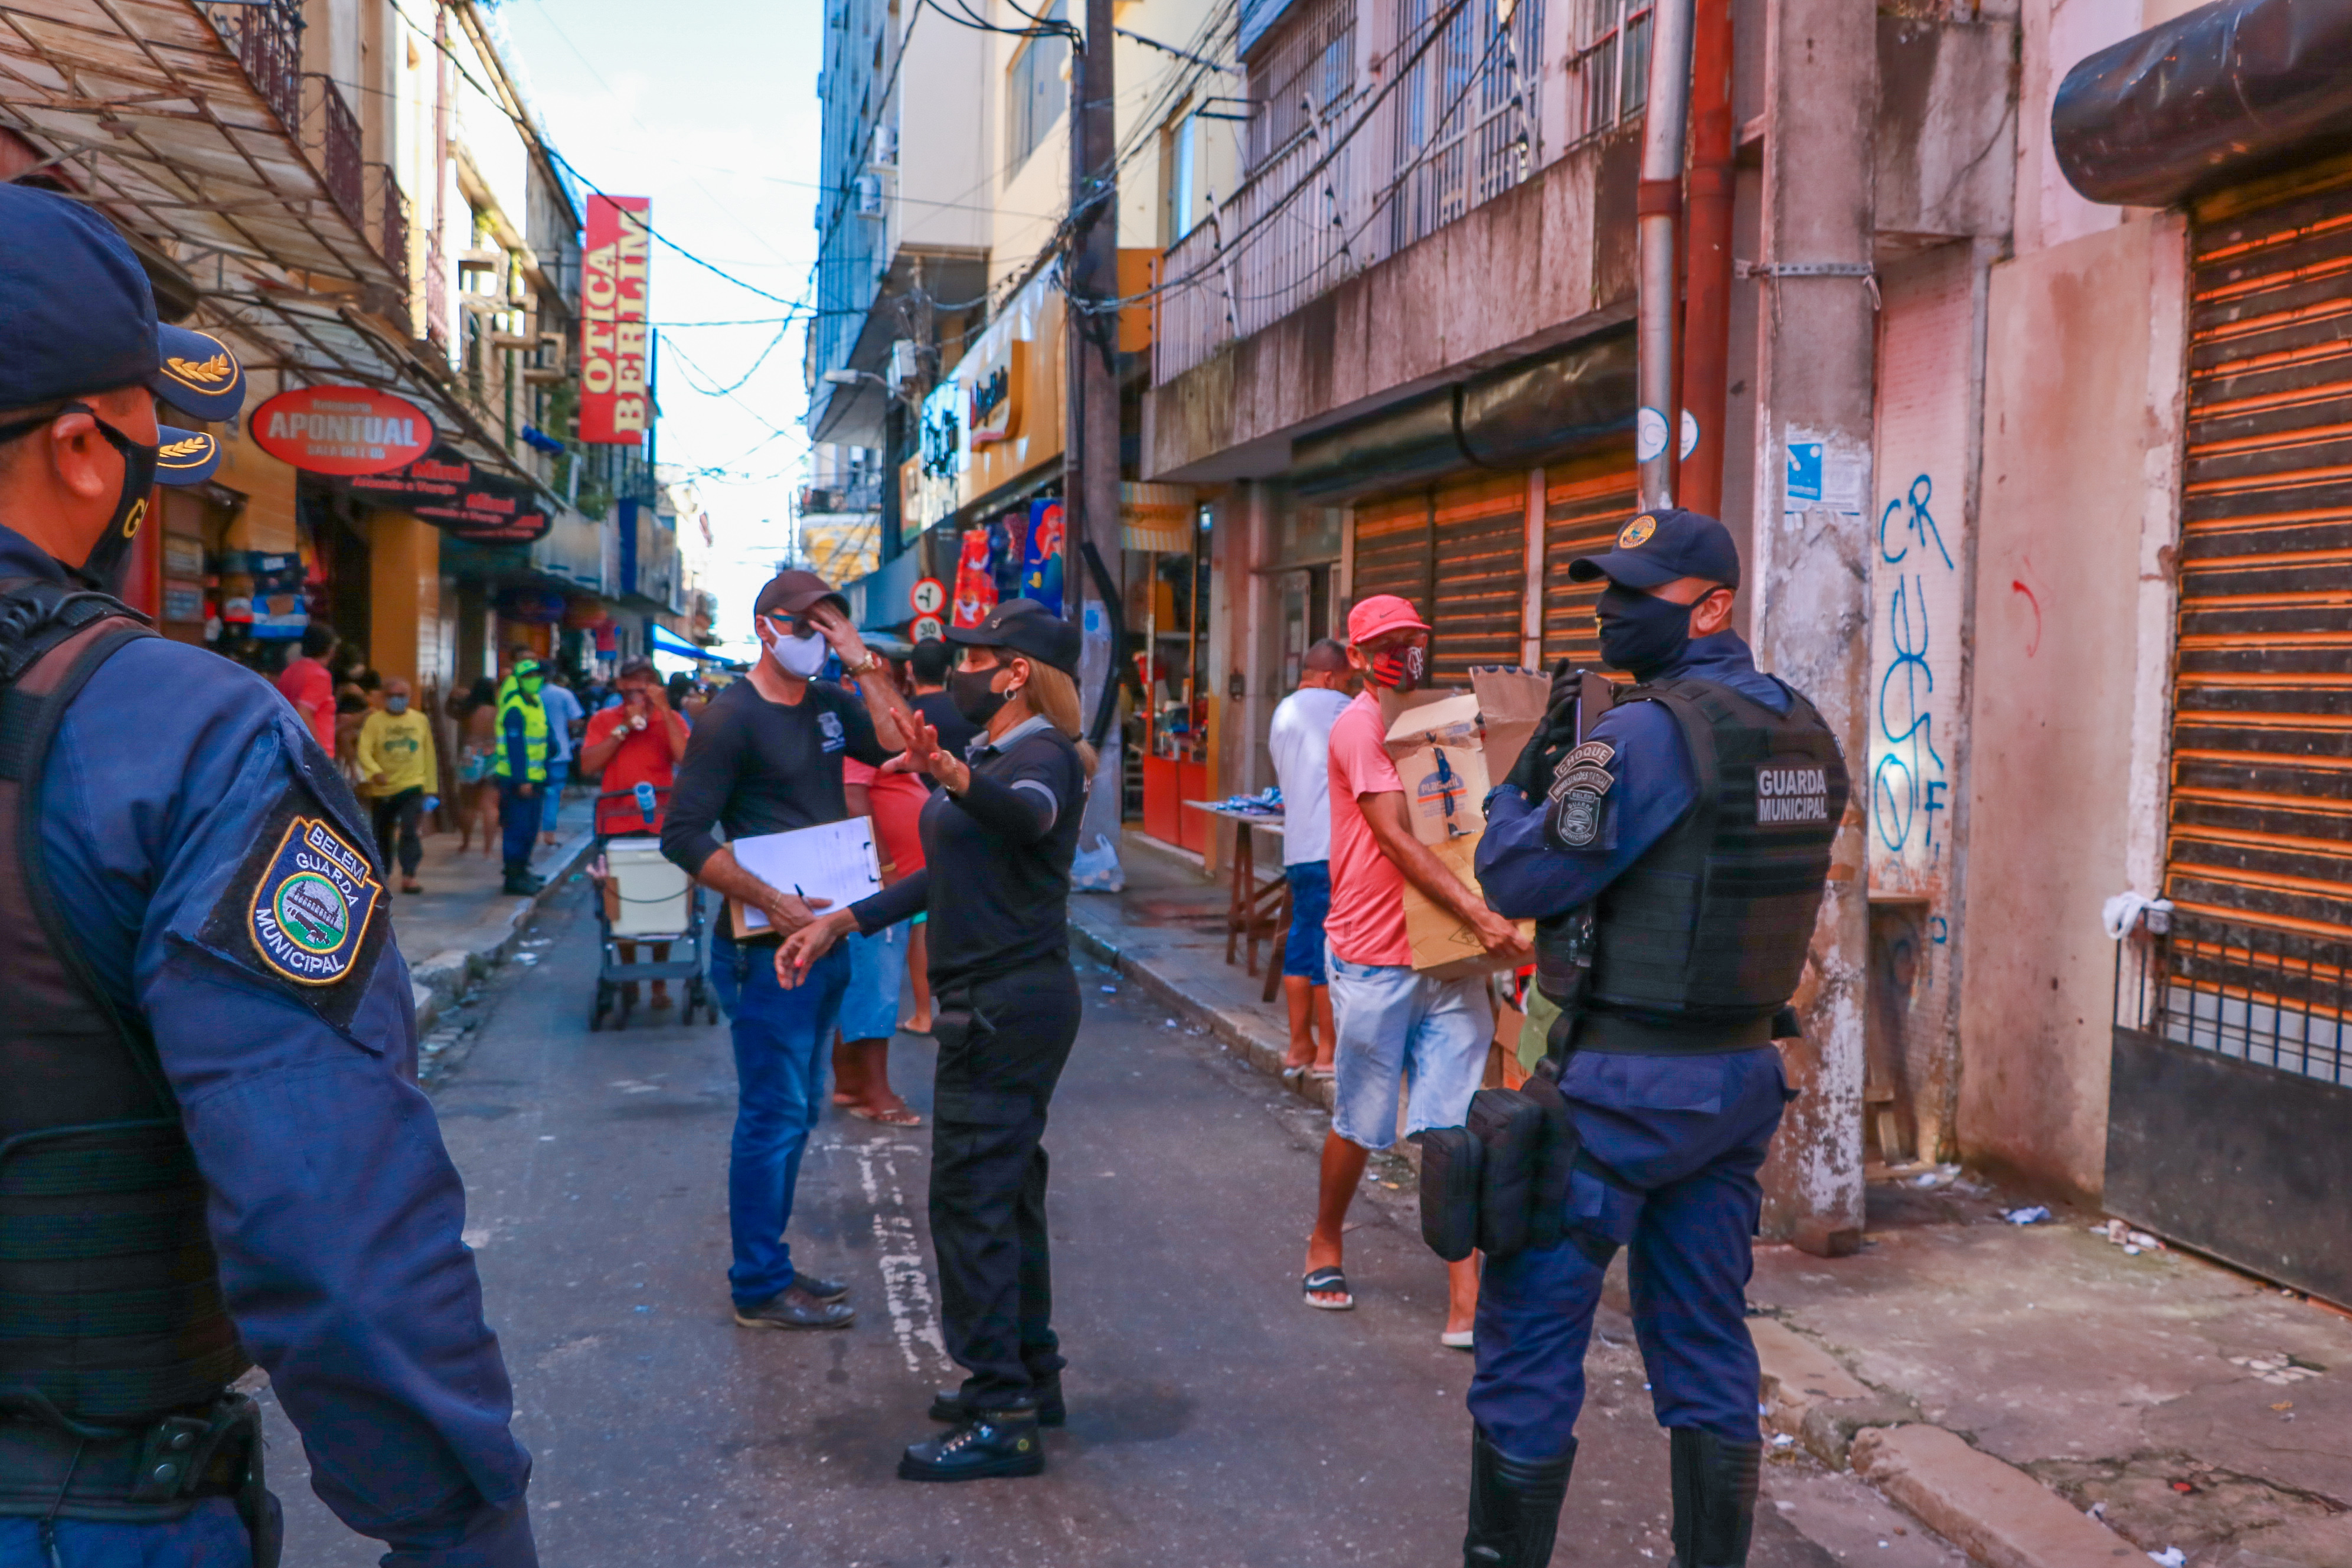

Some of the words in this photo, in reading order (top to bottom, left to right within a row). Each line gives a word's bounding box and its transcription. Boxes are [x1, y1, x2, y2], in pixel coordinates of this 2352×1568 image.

[613, 207, 649, 435] BERLIM
[267, 411, 420, 447] APONTUAL
[919, 621, 936, 636] 30
[1560, 746, 1609, 774] CHOQUE
[1760, 769, 1827, 796] GUARDA
[1568, 801, 1593, 812] GUARDA
[1760, 796, 1828, 822] MUNICIPAL
[1561, 827, 1593, 841] MUNICIPAL
[309, 826, 364, 881] BELÉM
[296, 852, 360, 907] GUARDA
[256, 908, 345, 974] MUNICIPAL
